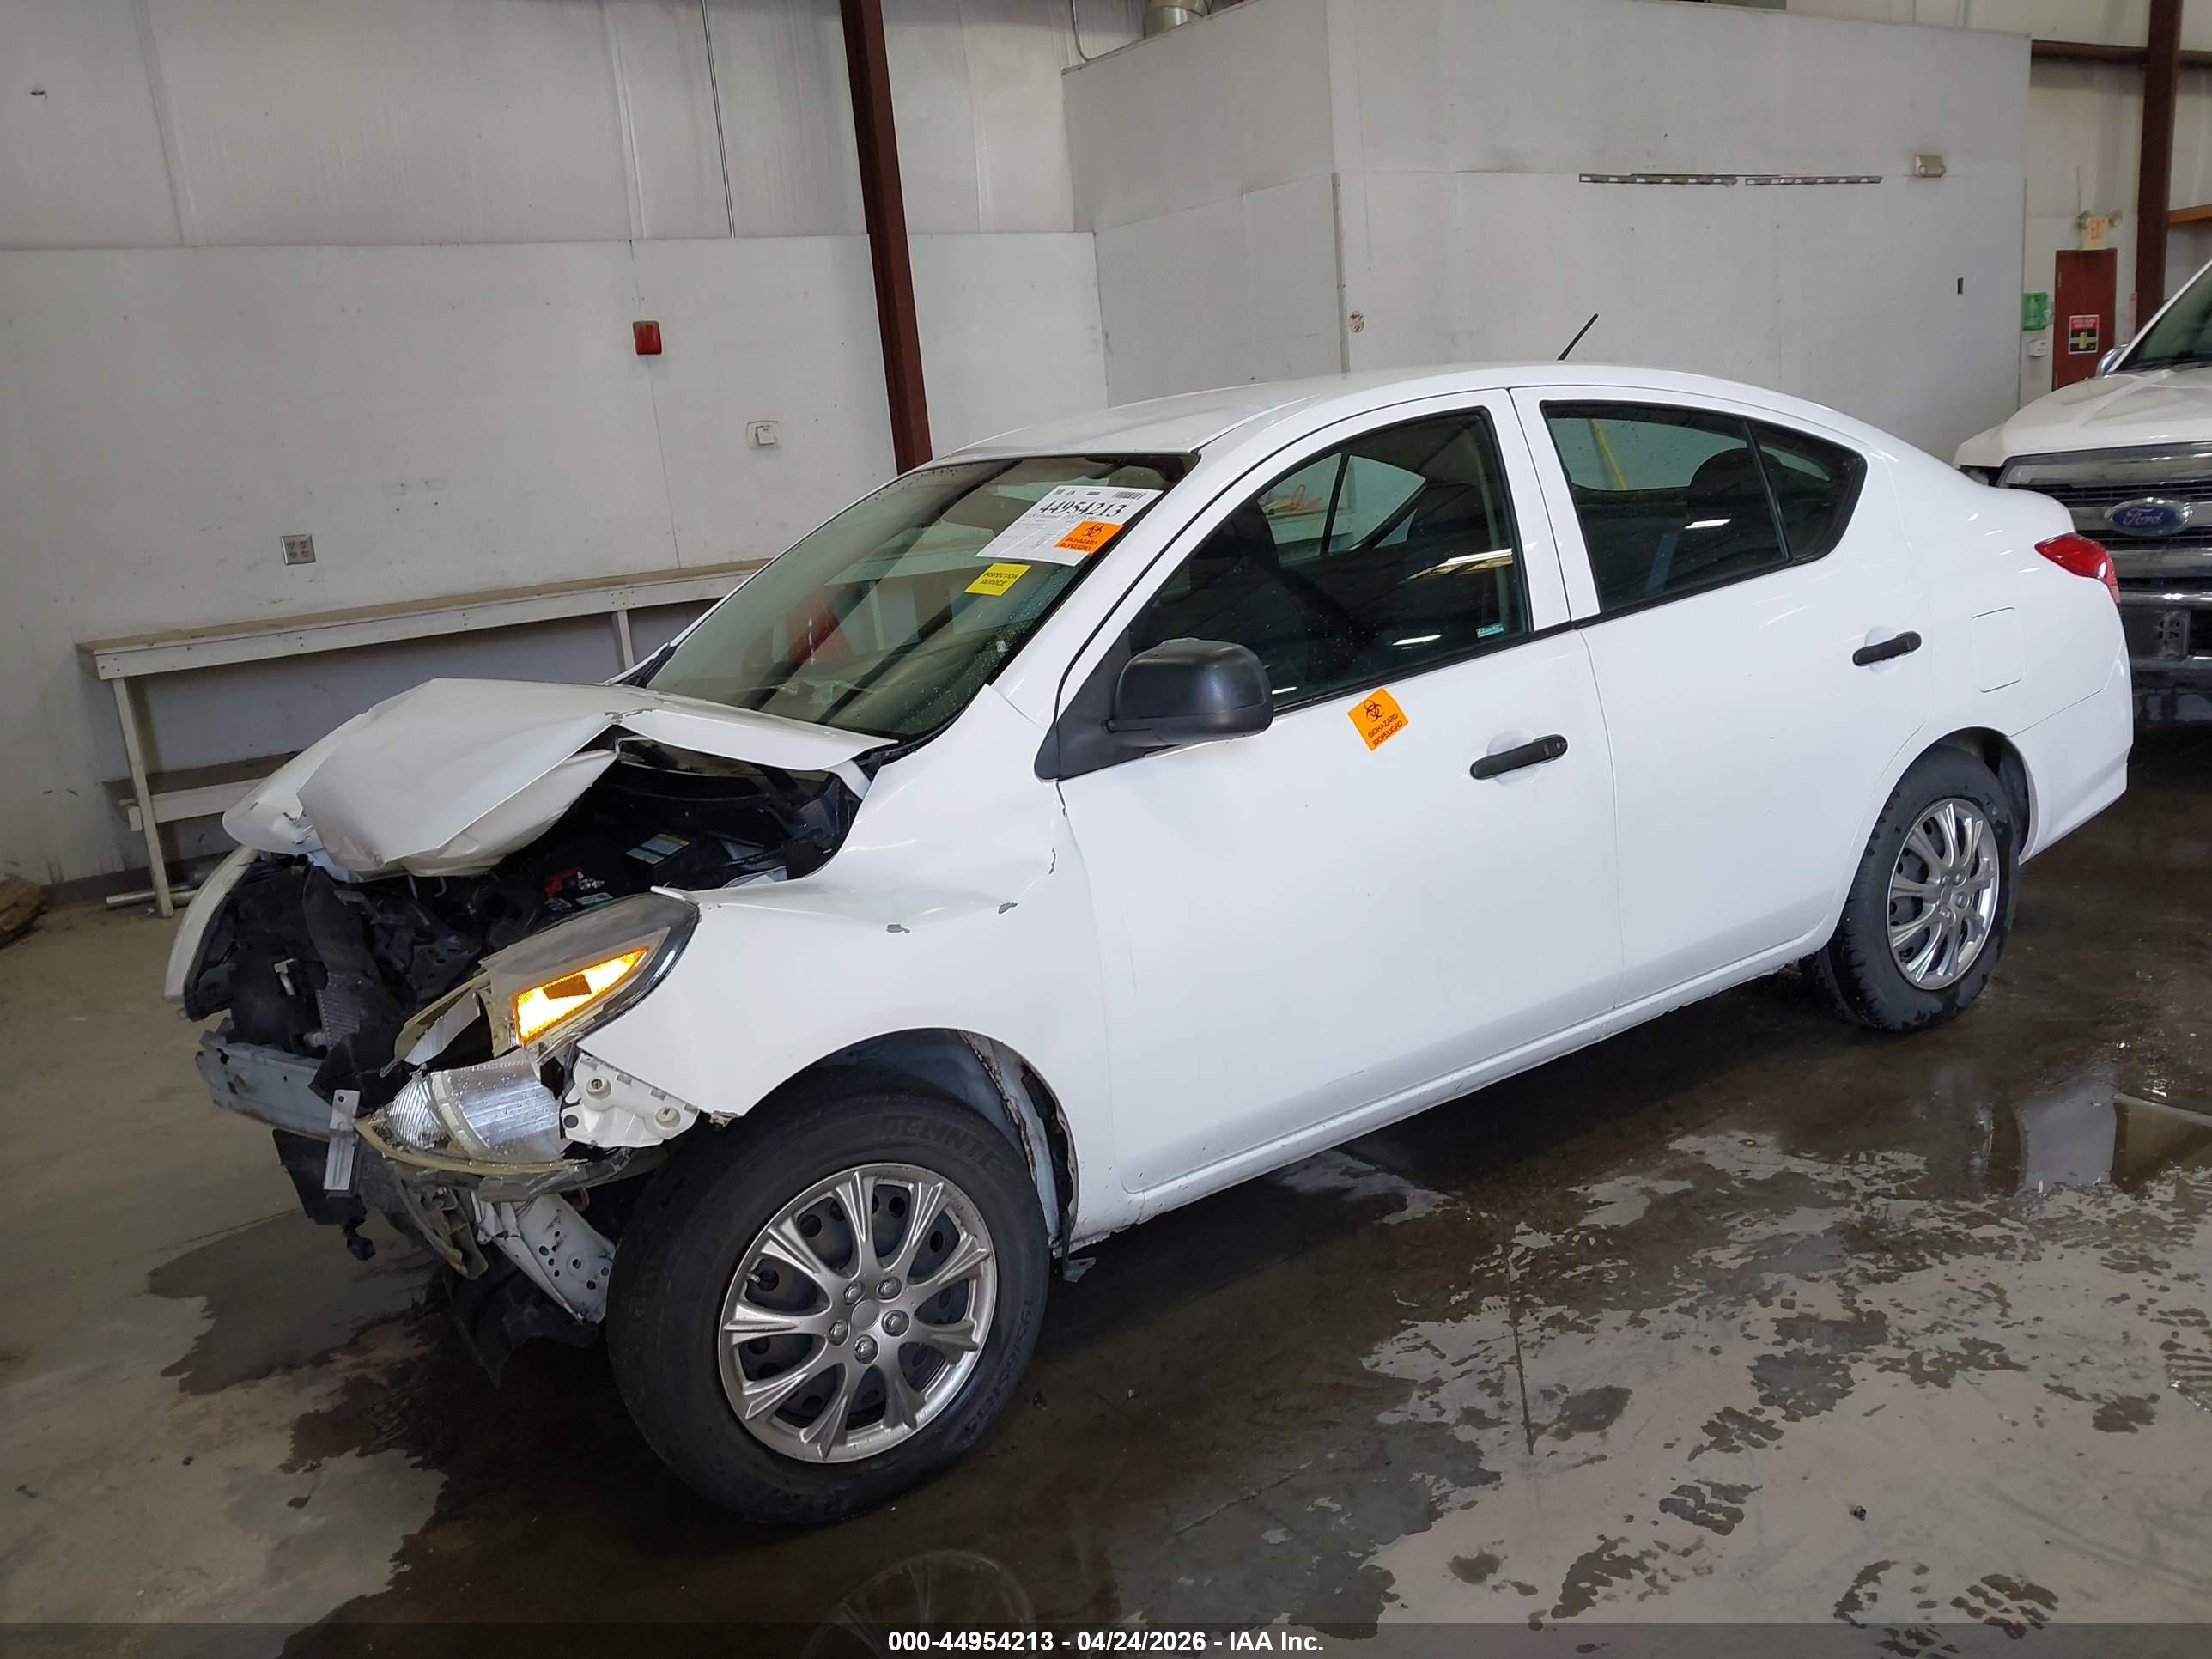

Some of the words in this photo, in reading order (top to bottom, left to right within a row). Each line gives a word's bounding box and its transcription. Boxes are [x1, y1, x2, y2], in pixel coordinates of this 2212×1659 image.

[1039, 500, 1127, 518] 44954213
[2122, 507, 2165, 526] Ford
[983, 571, 1018, 580] INSPECTION
[1367, 713, 1399, 738] BIOHAZARD
